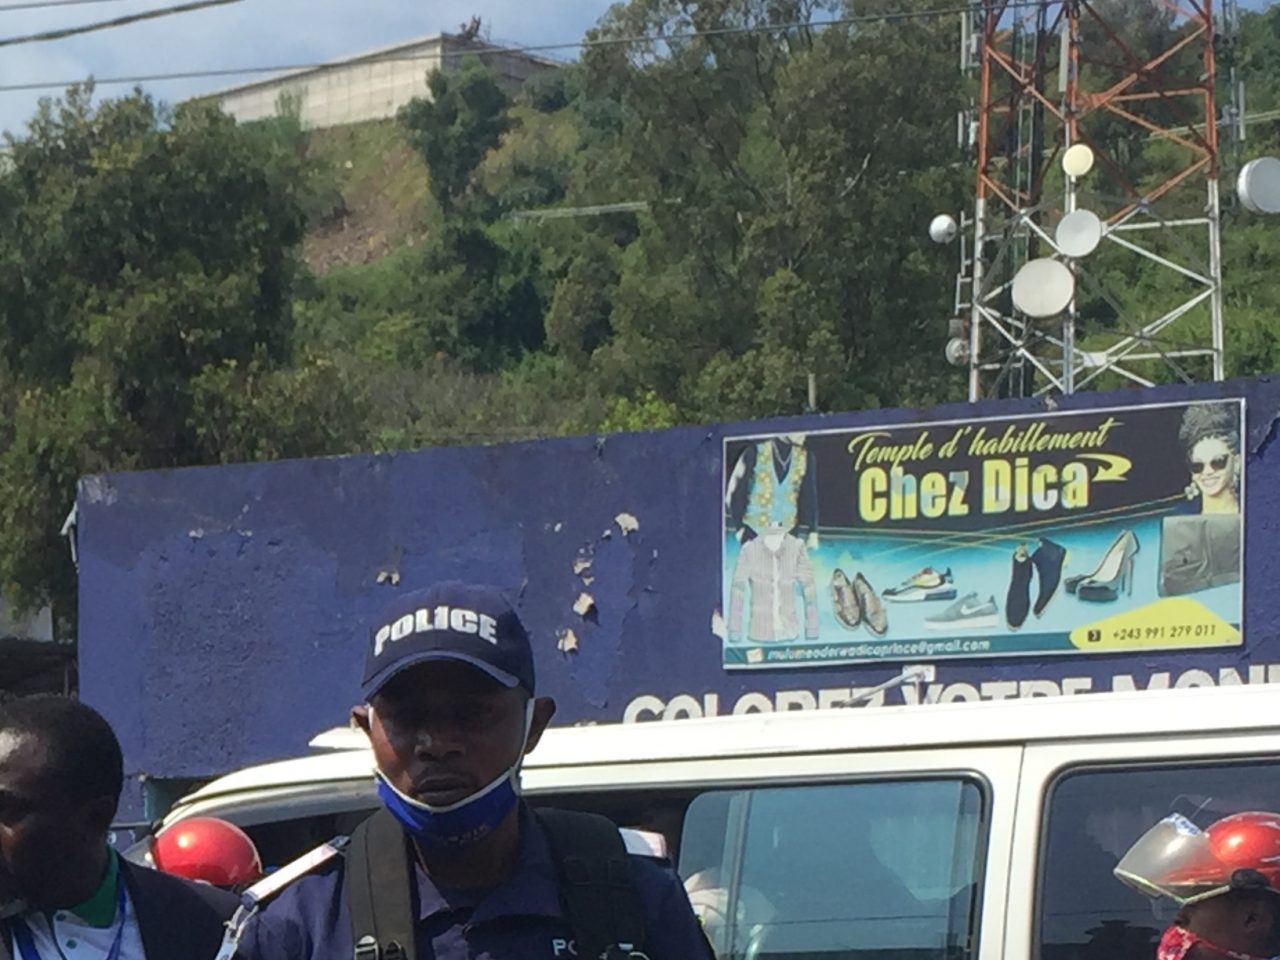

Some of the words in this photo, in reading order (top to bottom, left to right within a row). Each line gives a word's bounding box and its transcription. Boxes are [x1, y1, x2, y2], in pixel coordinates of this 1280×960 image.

[848, 431, 934, 471] Temple
[858, 464, 970, 522] Chez
[981, 456, 1090, 515] Dica
[373, 605, 498, 657] POLICE
[1113, 628, 1141, 641] +243
[1145, 627, 1165, 639] 991
[1169, 625, 1192, 638] 279
[1194, 624, 1217, 636] 011
